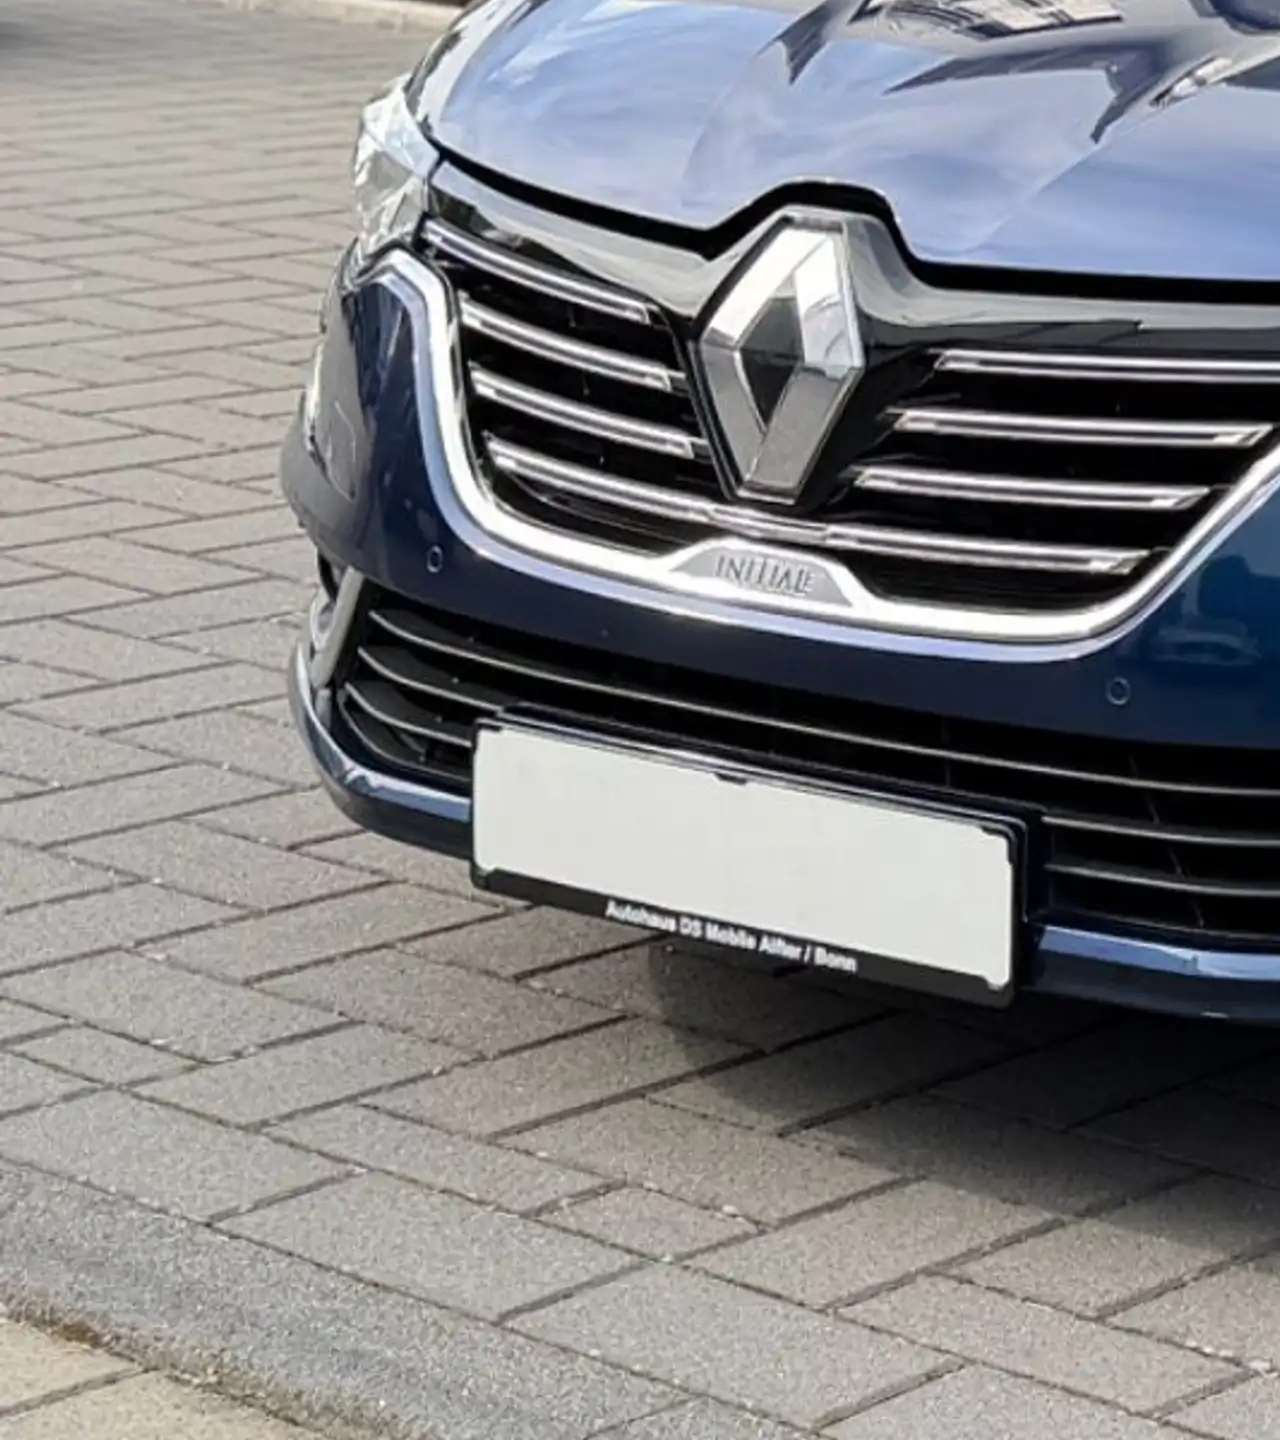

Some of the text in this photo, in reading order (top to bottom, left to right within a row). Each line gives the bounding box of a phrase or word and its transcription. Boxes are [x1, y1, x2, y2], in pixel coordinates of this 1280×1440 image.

[714, 553, 816, 597] INITIALE
[604, 899, 677, 932] Autohaus
[705, 922, 756, 950] Mobile
[813, 947, 859, 973] Bonn
